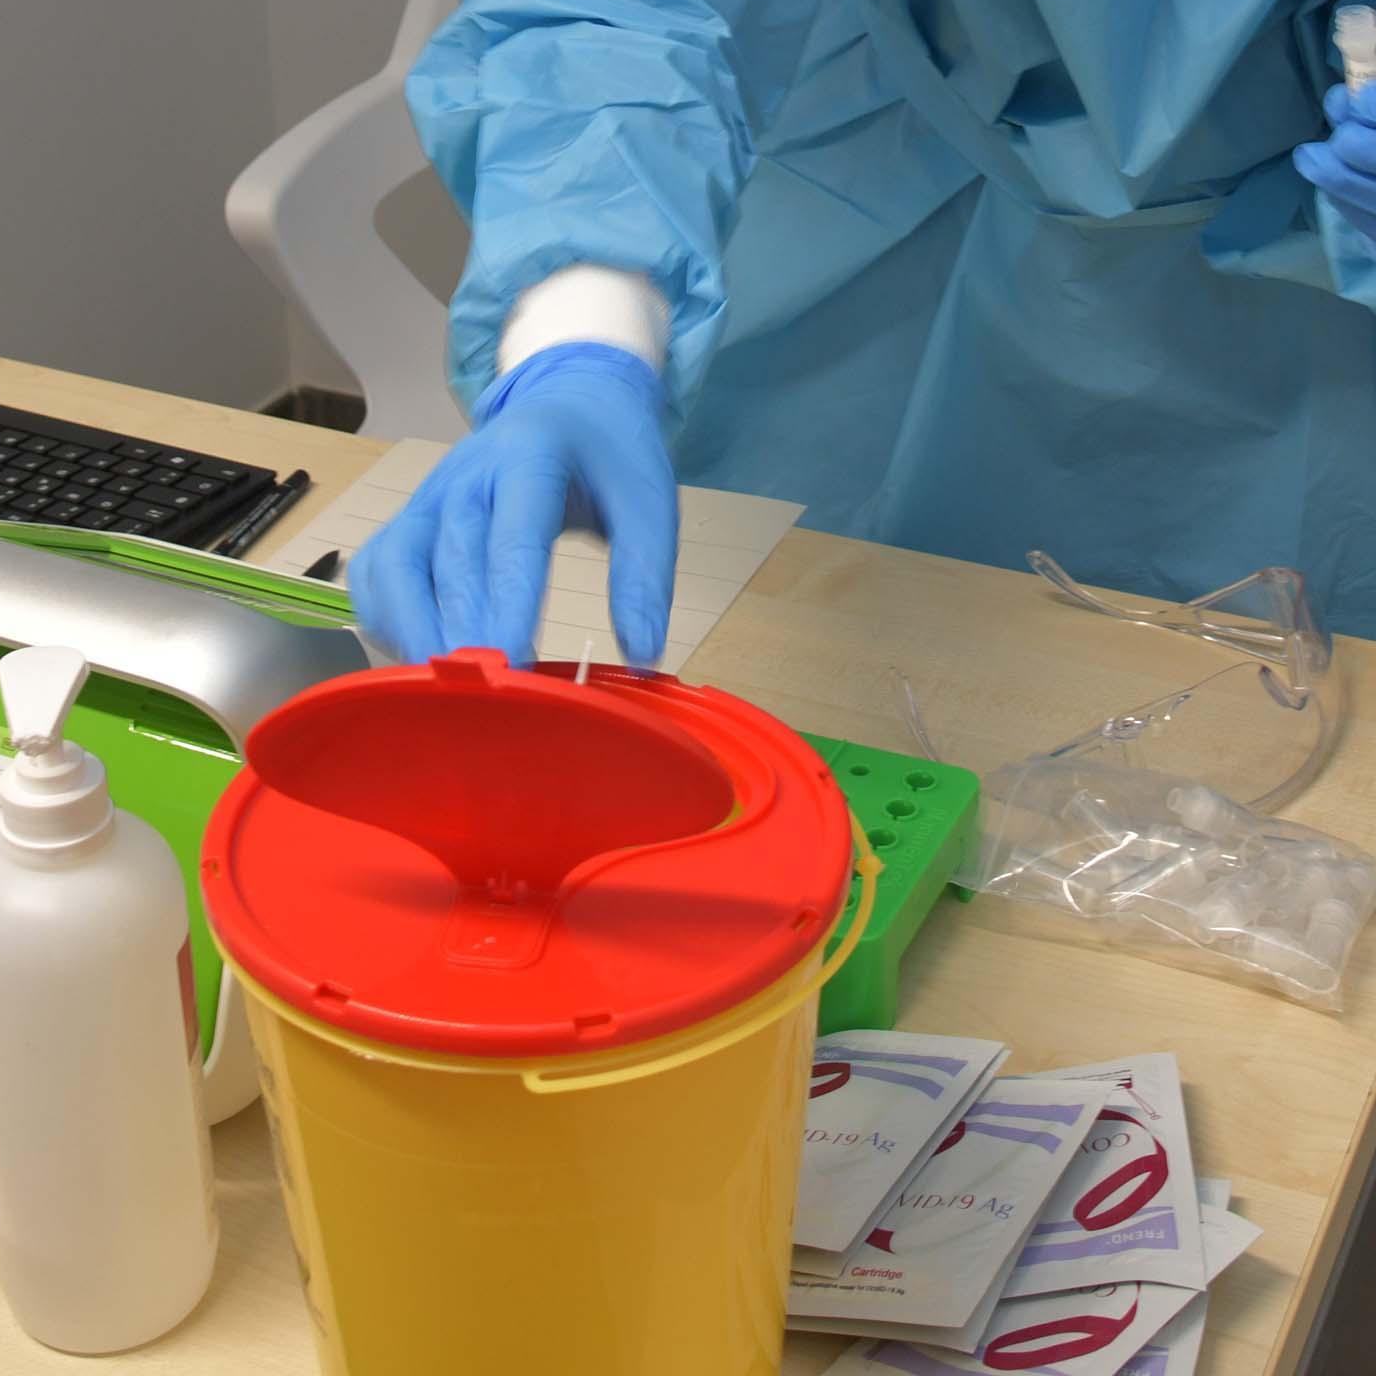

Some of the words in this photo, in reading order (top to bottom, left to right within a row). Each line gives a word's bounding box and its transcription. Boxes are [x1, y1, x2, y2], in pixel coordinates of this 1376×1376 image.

[861, 1131, 897, 1153] Ag
[976, 1196, 1015, 1220] Ag
[1110, 1228, 1166, 1245] FREND
[851, 1266, 903, 1281] Cartridge
